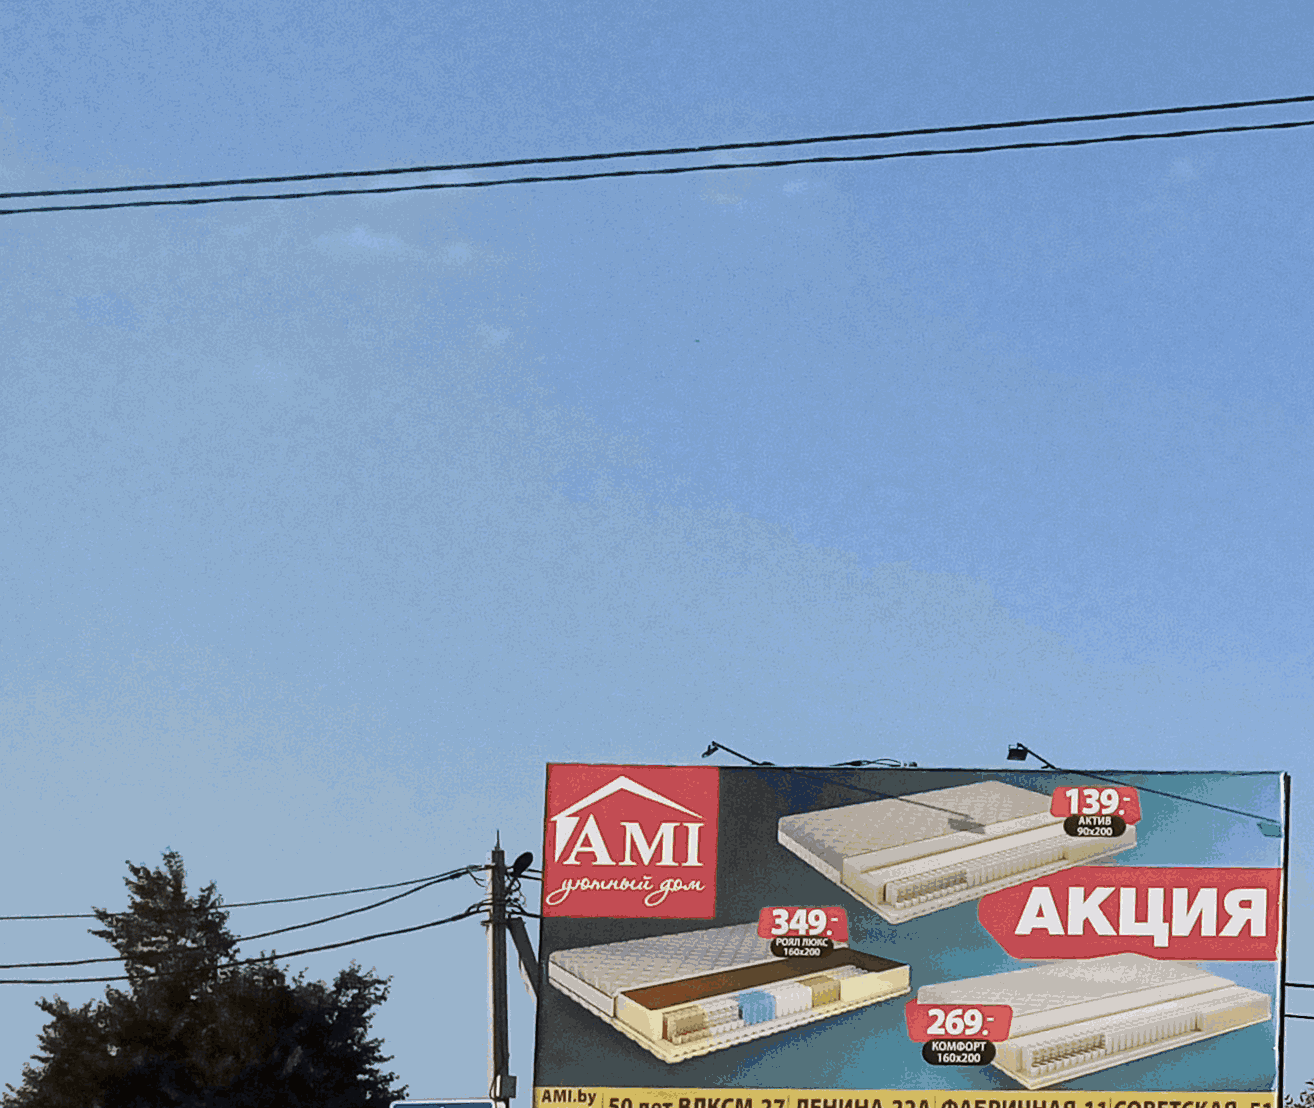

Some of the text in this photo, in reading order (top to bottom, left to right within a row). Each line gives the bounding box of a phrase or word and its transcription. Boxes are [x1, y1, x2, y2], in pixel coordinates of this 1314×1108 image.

[1078, 816, 1112, 826] АКТИВ
[562, 813, 705, 867] AMI
[546, 875, 706, 907] уютный дом
[1014, 886, 1268, 948] АКЦИЯ
[931, 1041, 987, 1052] КОМФОРТ
[541, 1089, 597, 1107] AMI.by
